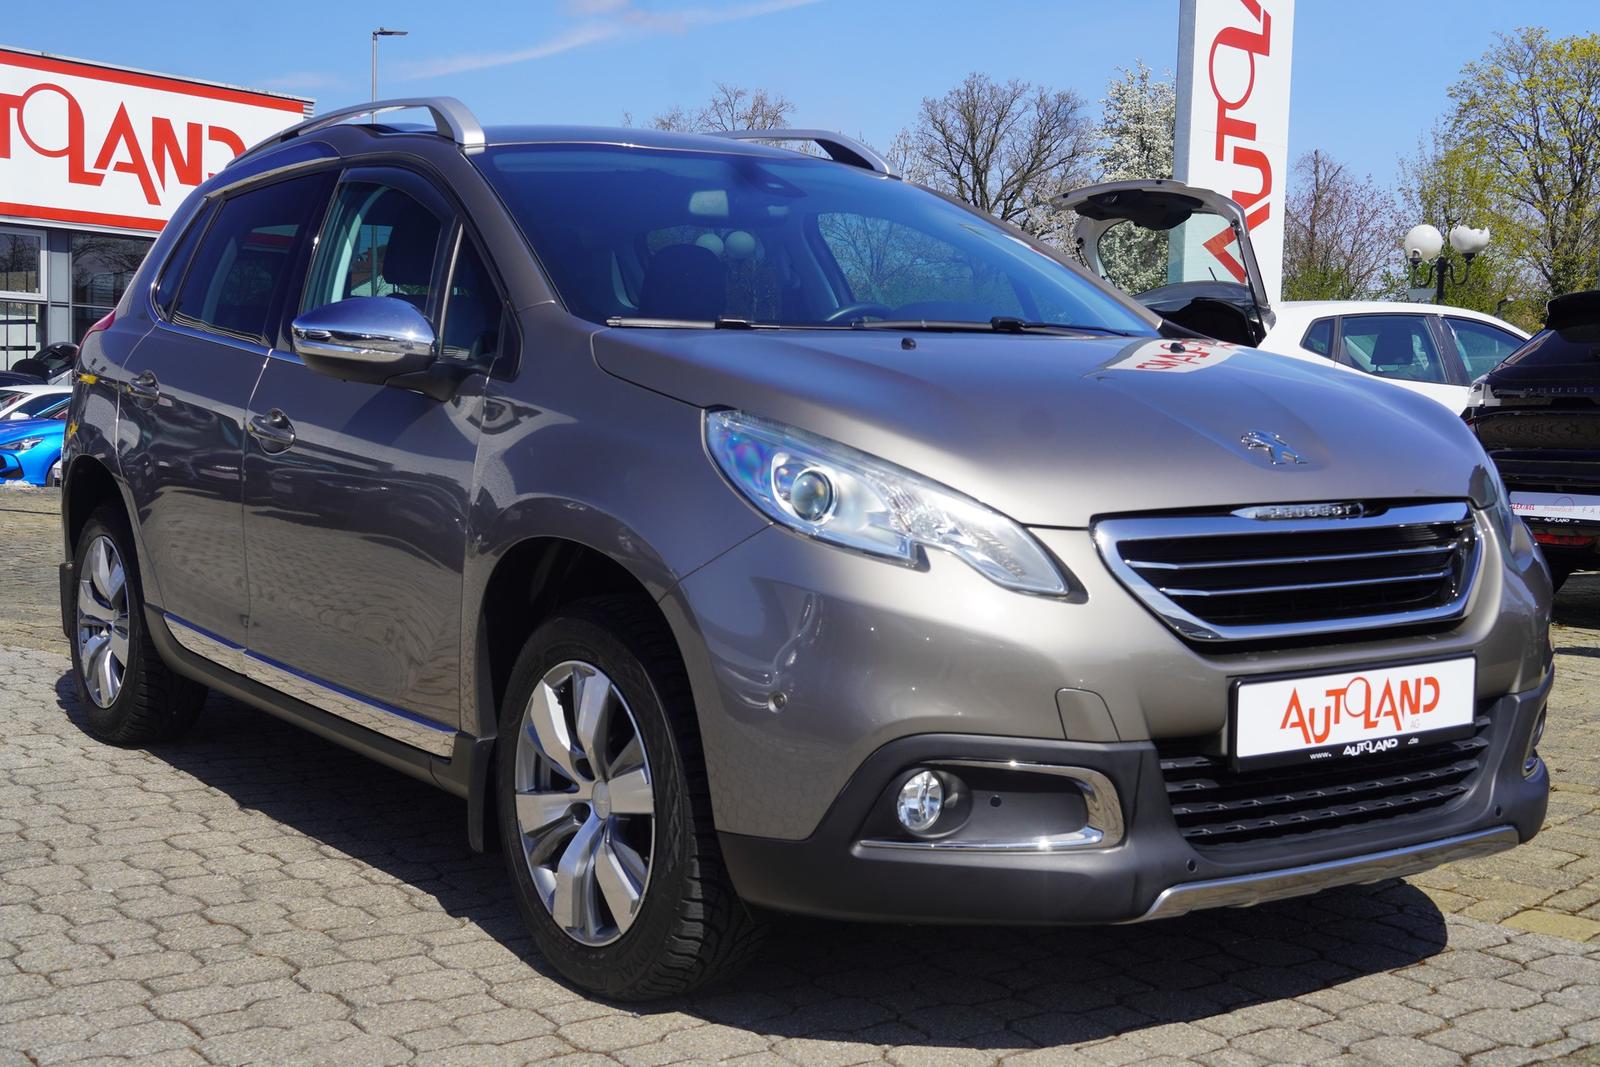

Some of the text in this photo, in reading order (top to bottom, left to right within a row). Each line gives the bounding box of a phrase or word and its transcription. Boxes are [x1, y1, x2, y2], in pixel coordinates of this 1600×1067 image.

[1202, 0, 1272, 284] AUTOL
[1280, 677, 1441, 744] AUTOLAND
[1410, 719, 1420, 729] AG
[1310, 736, 1419, 760] www. AUTOLAND .de
